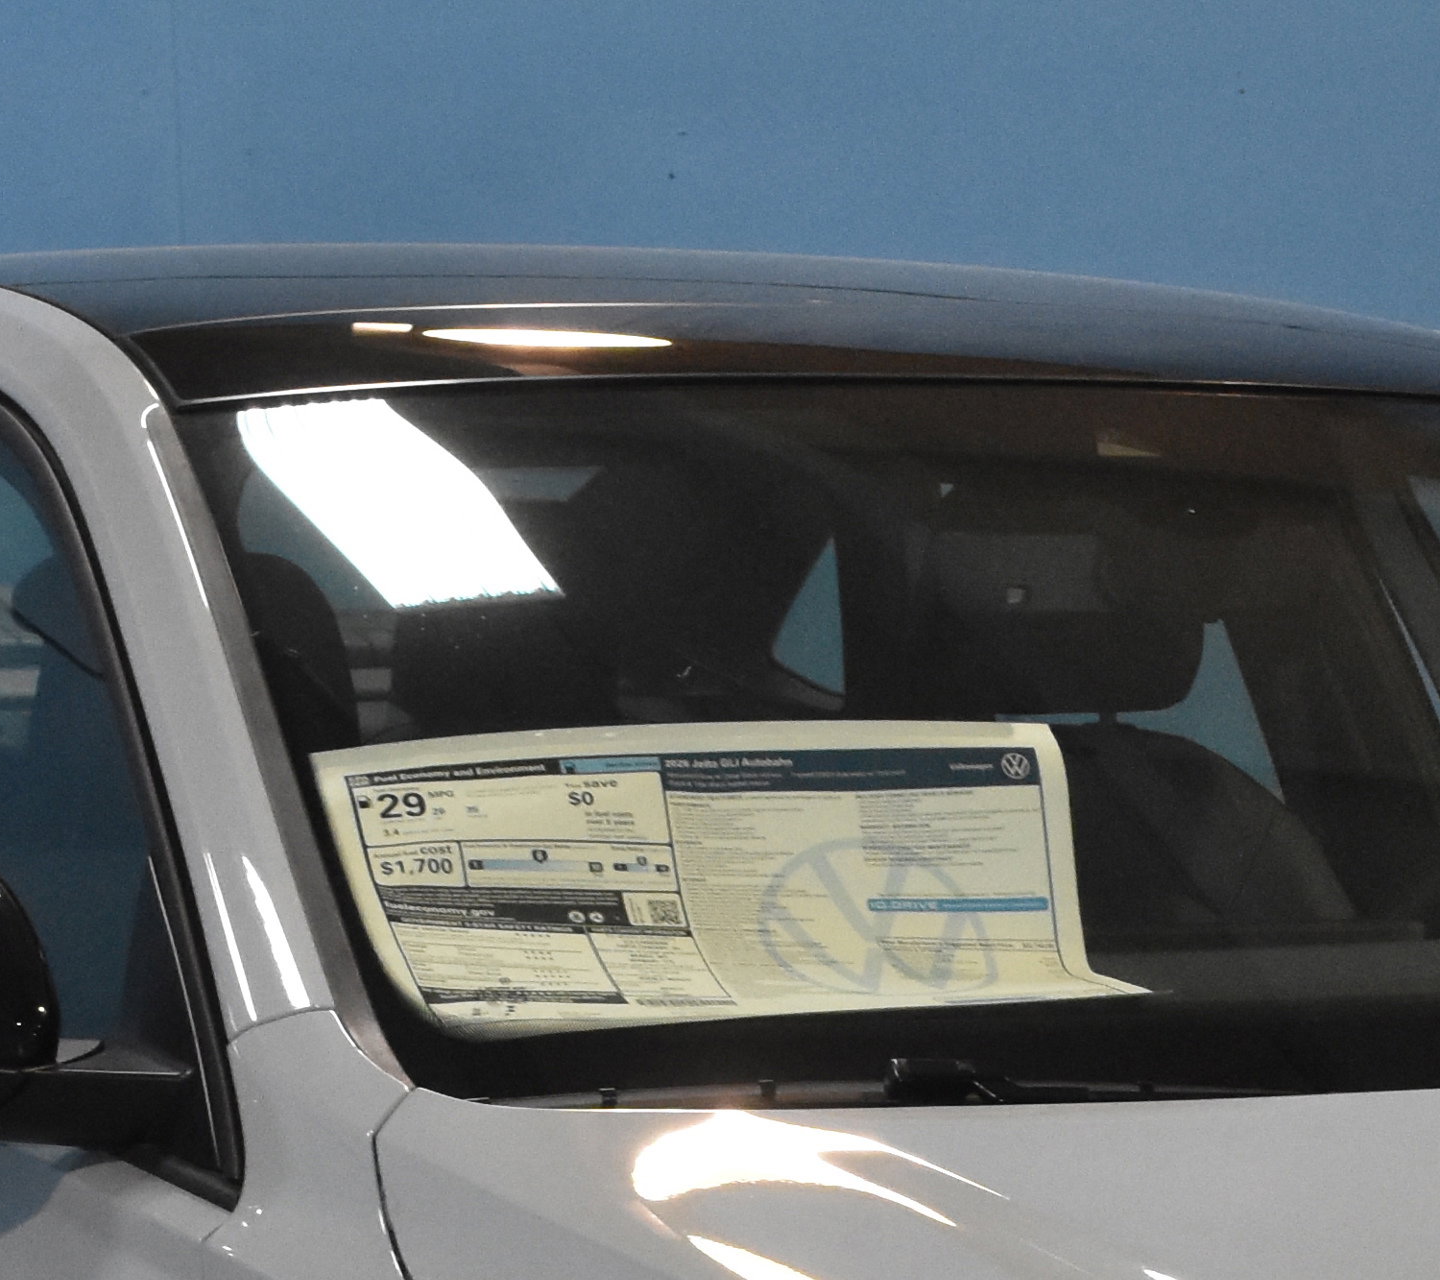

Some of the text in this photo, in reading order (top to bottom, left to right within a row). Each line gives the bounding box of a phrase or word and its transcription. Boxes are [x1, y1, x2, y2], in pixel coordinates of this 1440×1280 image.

[400, 770, 450, 781] Economy
[453, 767, 474, 777] and
[476, 763, 546, 776] Environment
[582, 779, 618, 788] save
[377, 793, 427, 819] 29
[568, 791, 594, 806] $0
[420, 845, 452, 855] cost
[380, 858, 453, 876] $1,700
[384, 900, 496, 917] fueleconomy.gov
